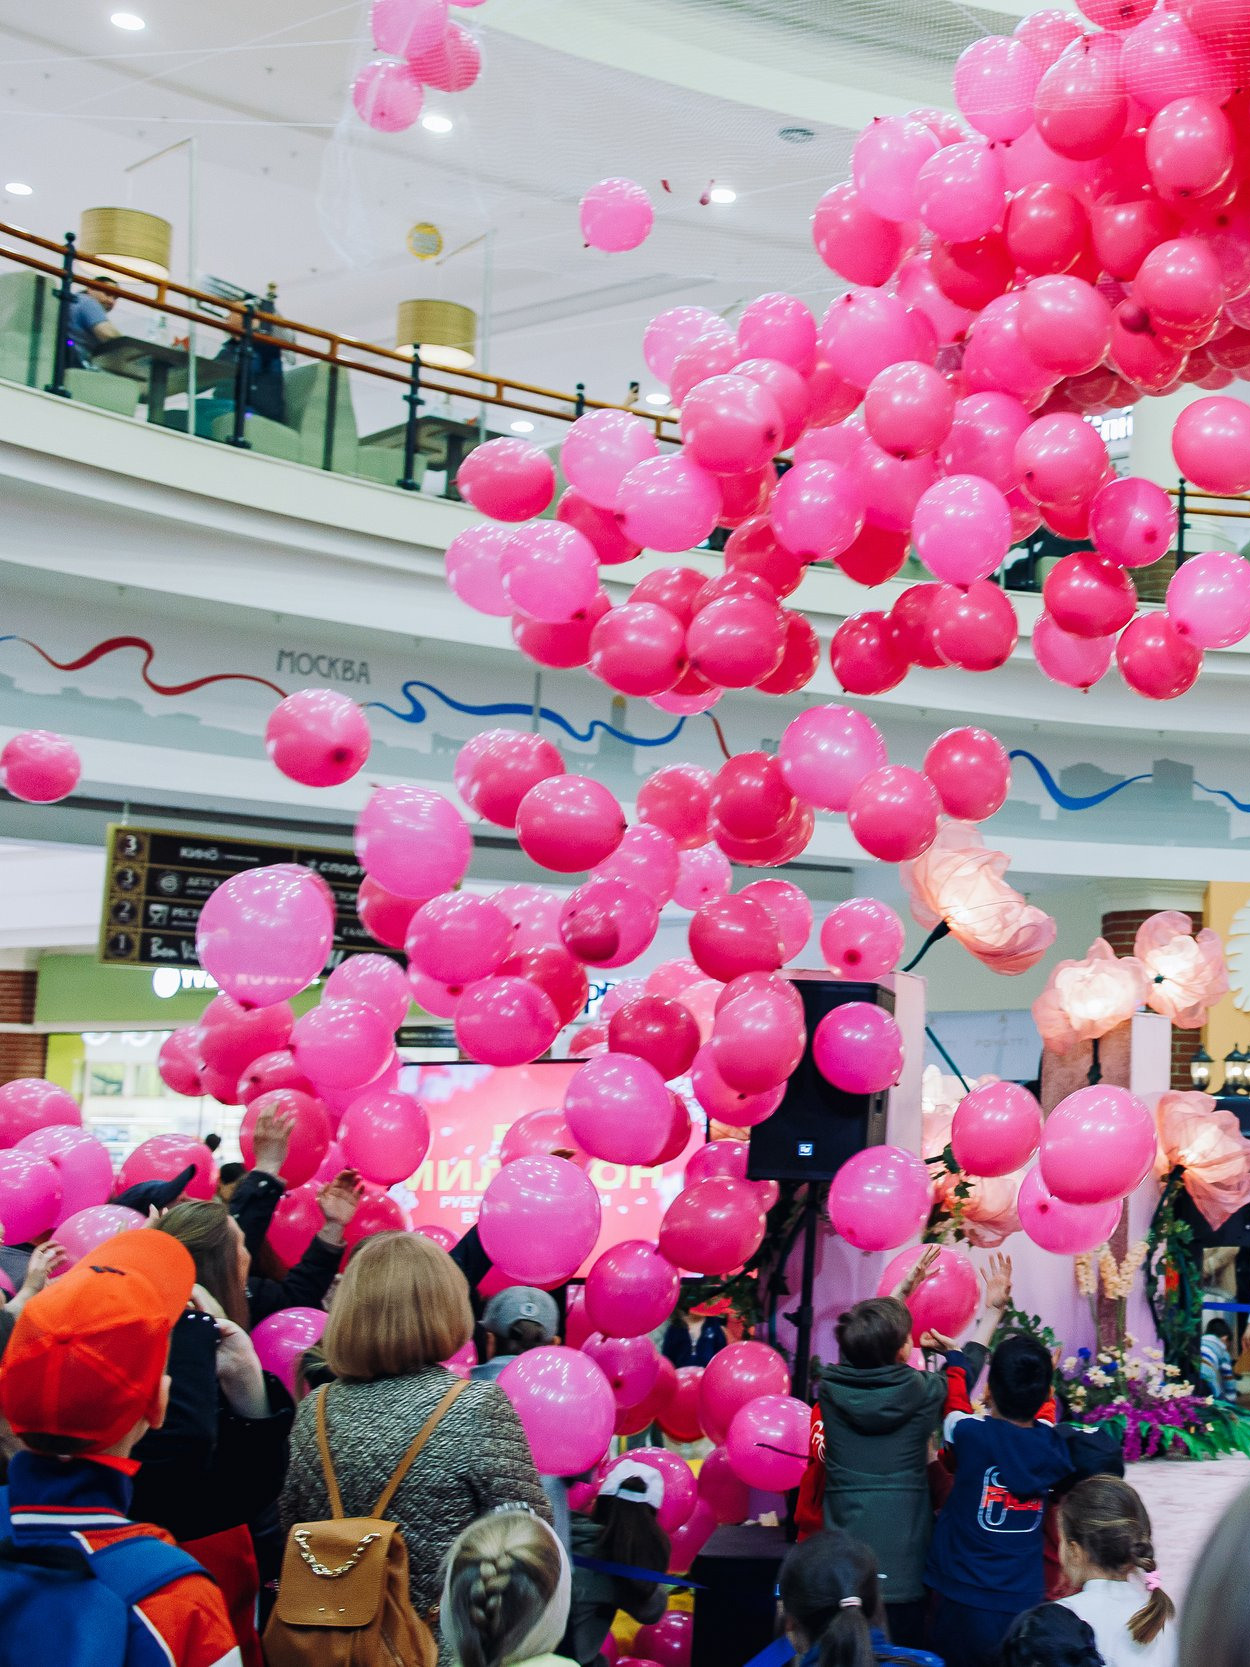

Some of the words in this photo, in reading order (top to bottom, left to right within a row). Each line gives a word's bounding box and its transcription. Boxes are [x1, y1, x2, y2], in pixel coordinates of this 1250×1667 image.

[276, 649, 370, 684] МОСКВА
[404, 1159, 664, 1193] МИЛОН
[439, 1195, 485, 1209] РУБЛ
